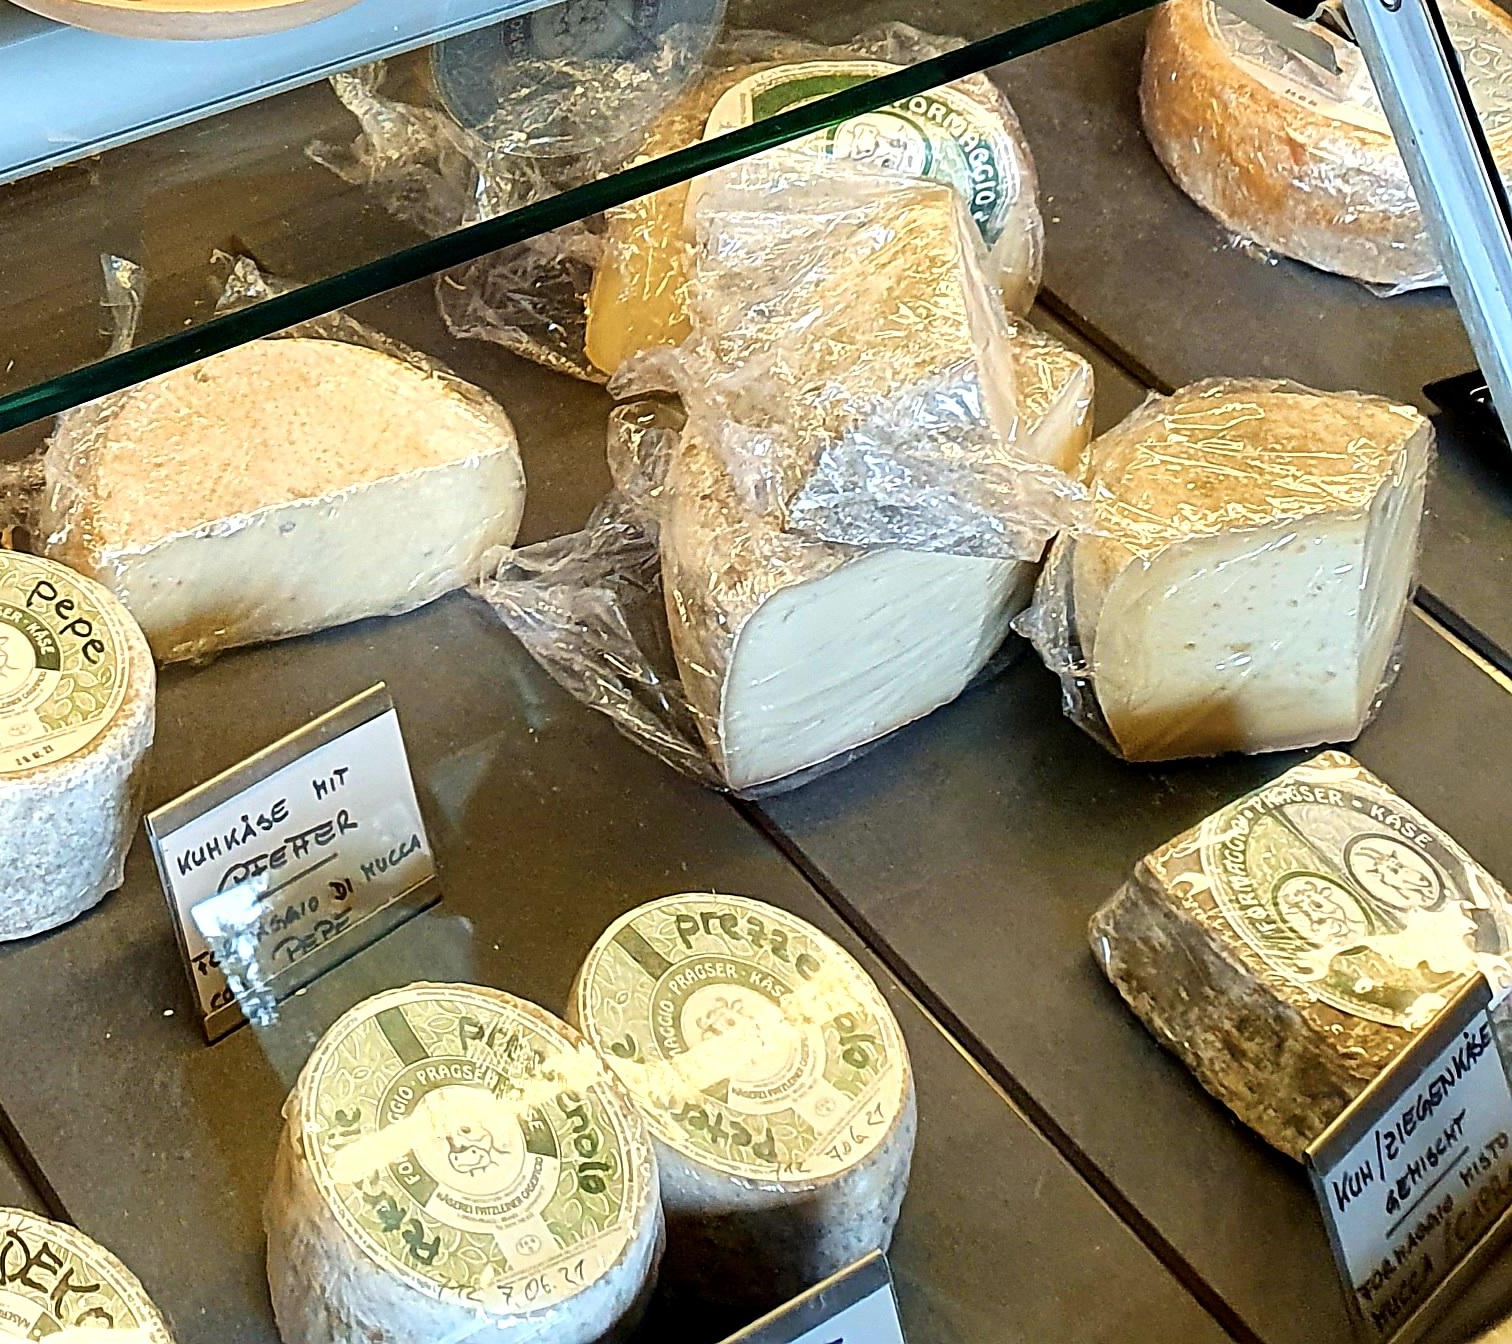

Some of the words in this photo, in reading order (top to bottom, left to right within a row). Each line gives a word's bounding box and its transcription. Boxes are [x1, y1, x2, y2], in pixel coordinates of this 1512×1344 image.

[902, 96, 997, 205] ORMAGGIO
[26, 621, 54, 656] KÄSE
[177, 798, 289, 878] KUHKÄSE
[1370, 803, 1434, 849] KÄSE
[328, 878, 354, 902] DI
[668, 962, 739, 997] PRAGSER
